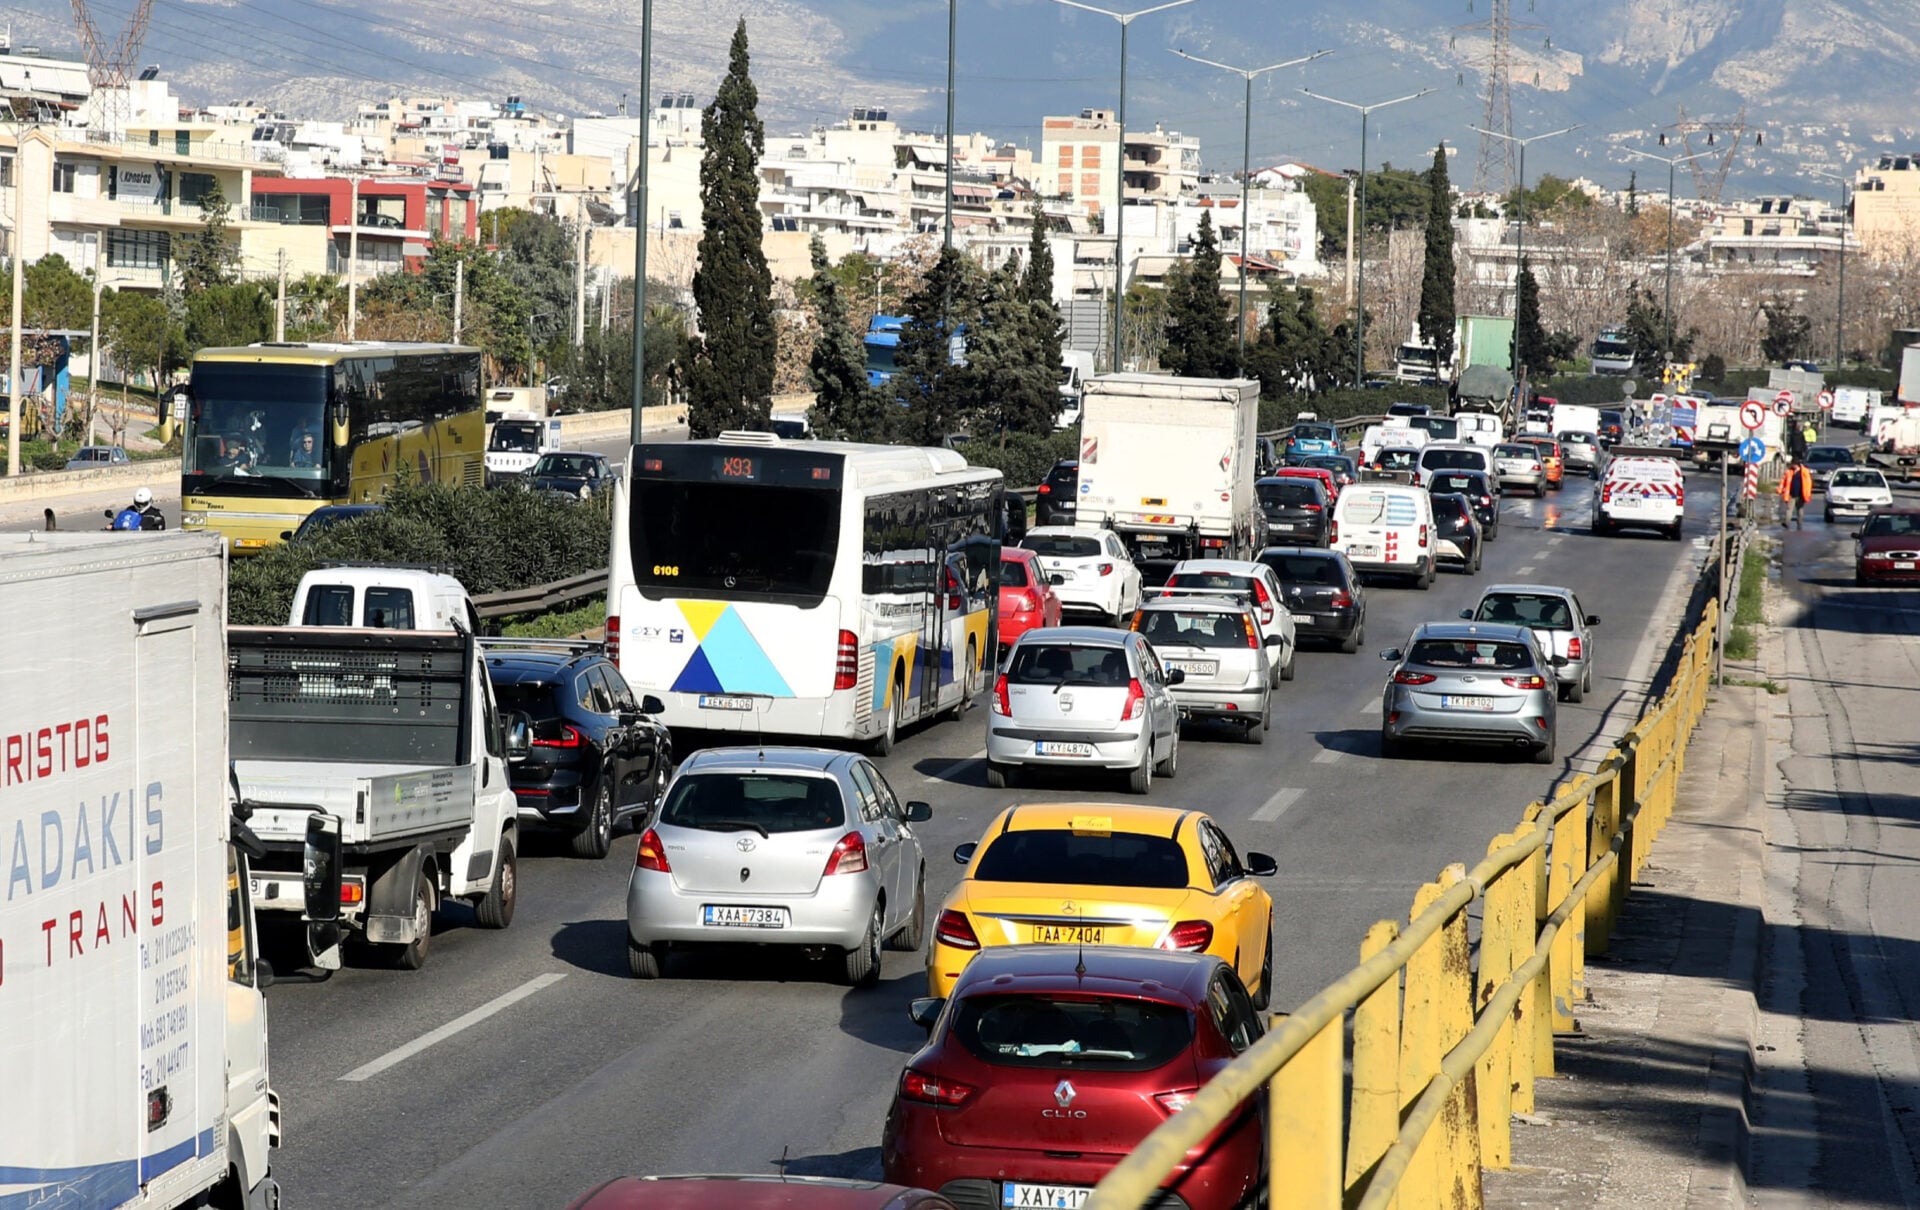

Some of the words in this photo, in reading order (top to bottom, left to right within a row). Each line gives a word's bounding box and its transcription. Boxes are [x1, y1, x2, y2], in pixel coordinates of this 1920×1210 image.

[723, 457, 753, 476] X93
[653, 565, 680, 577] 6106
[0, 714, 109, 789] RISTOS
[0, 781, 163, 901] ADAKIS
[42, 880, 164, 967] TRANS
[155, 974, 165, 1004] 210
[157, 1053, 166, 1084] 210
[1041, 1109, 1087, 1118] CLIO
